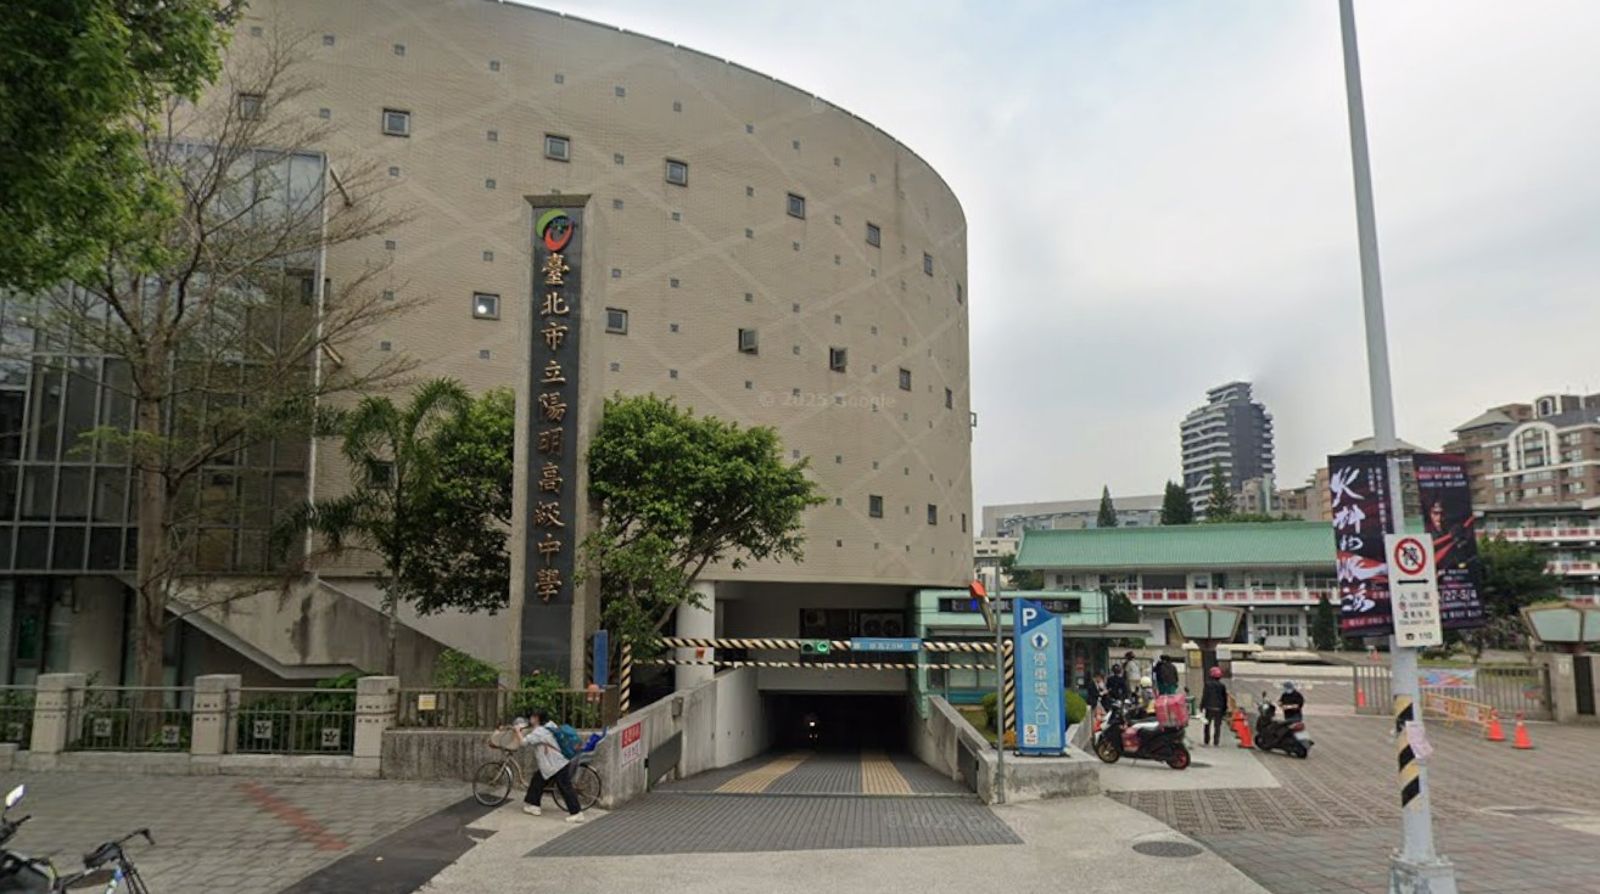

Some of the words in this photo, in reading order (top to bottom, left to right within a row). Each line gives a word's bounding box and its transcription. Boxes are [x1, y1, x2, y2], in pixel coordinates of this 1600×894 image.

[535, 252, 570, 601] 臺北市立陽明高級中學
[1022, 608, 1037, 626] P
[1033, 652, 1049, 725] 停車場入口
